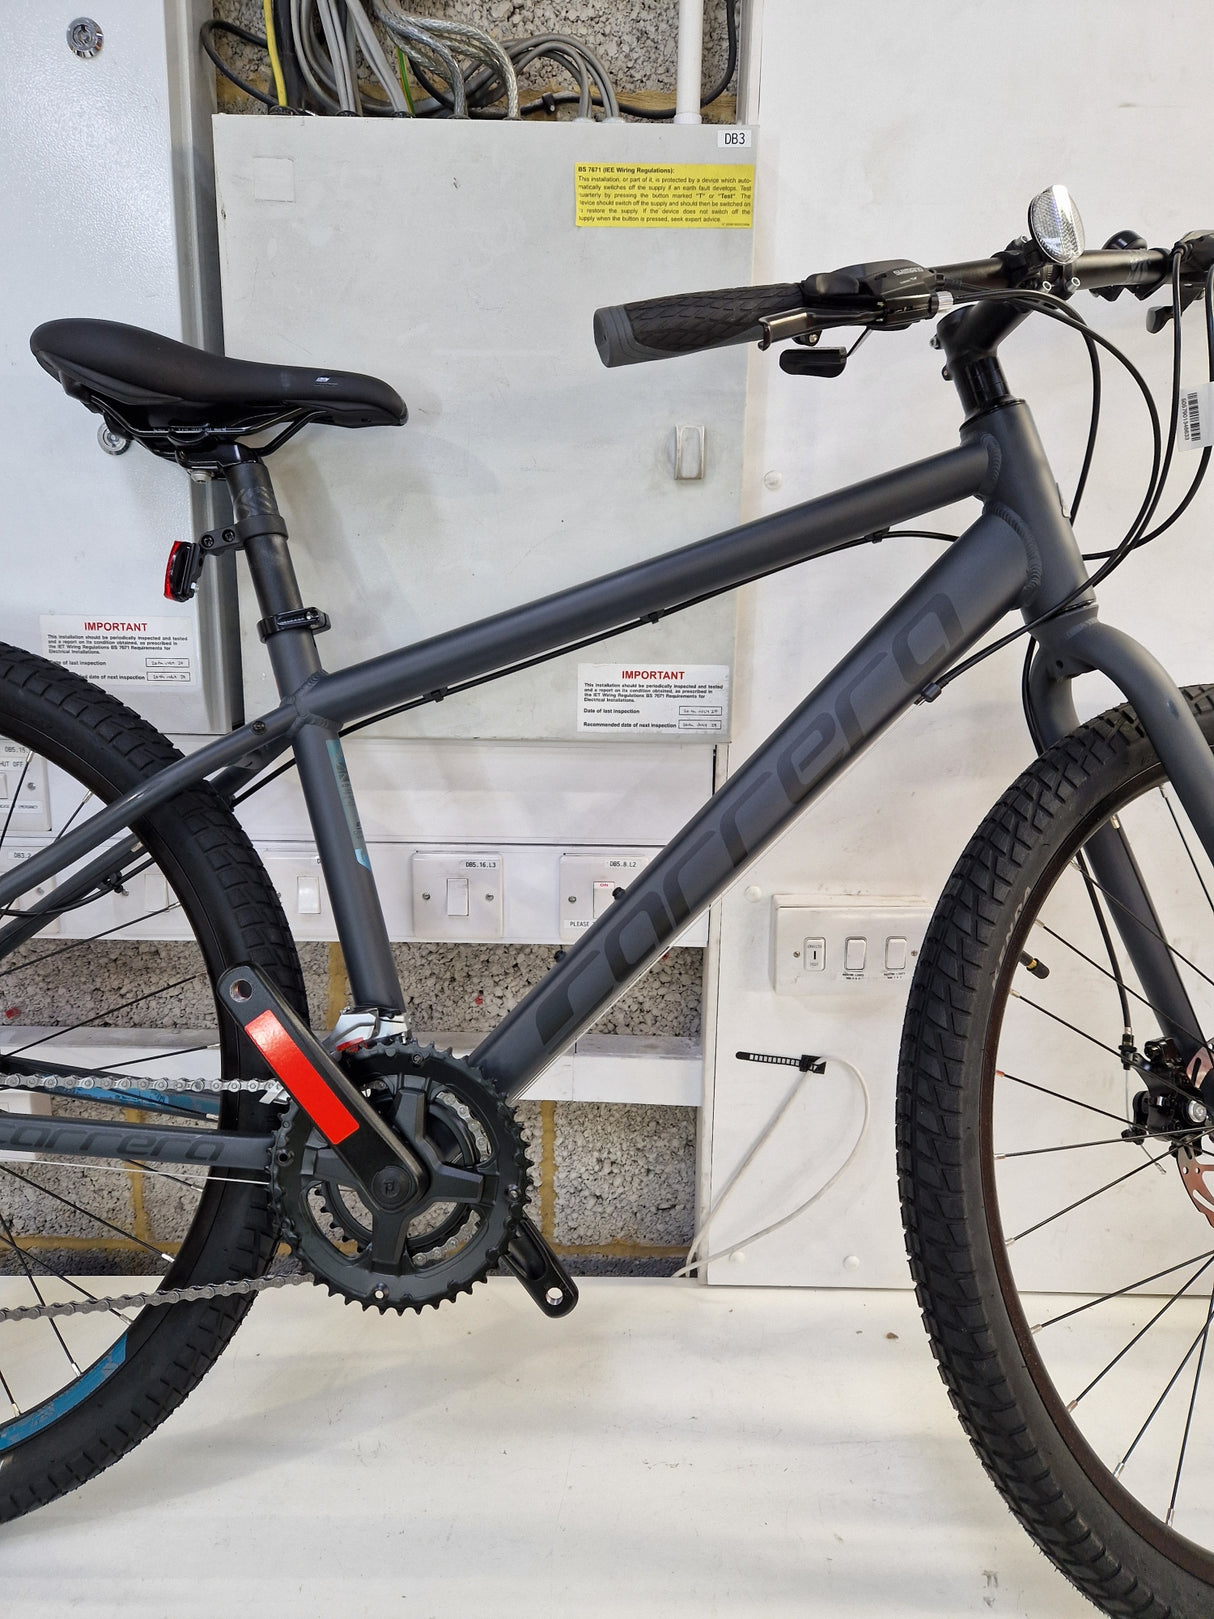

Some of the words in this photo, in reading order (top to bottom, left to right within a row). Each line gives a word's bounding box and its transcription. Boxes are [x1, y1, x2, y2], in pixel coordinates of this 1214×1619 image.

[725, 132, 745, 145] DB3
[84, 622, 147, 631] IMPORTANT
[622, 671, 685, 680] IMPORTANT
[535, 592, 964, 1046] carrera
[0, 1122, 226, 1162] arrera
